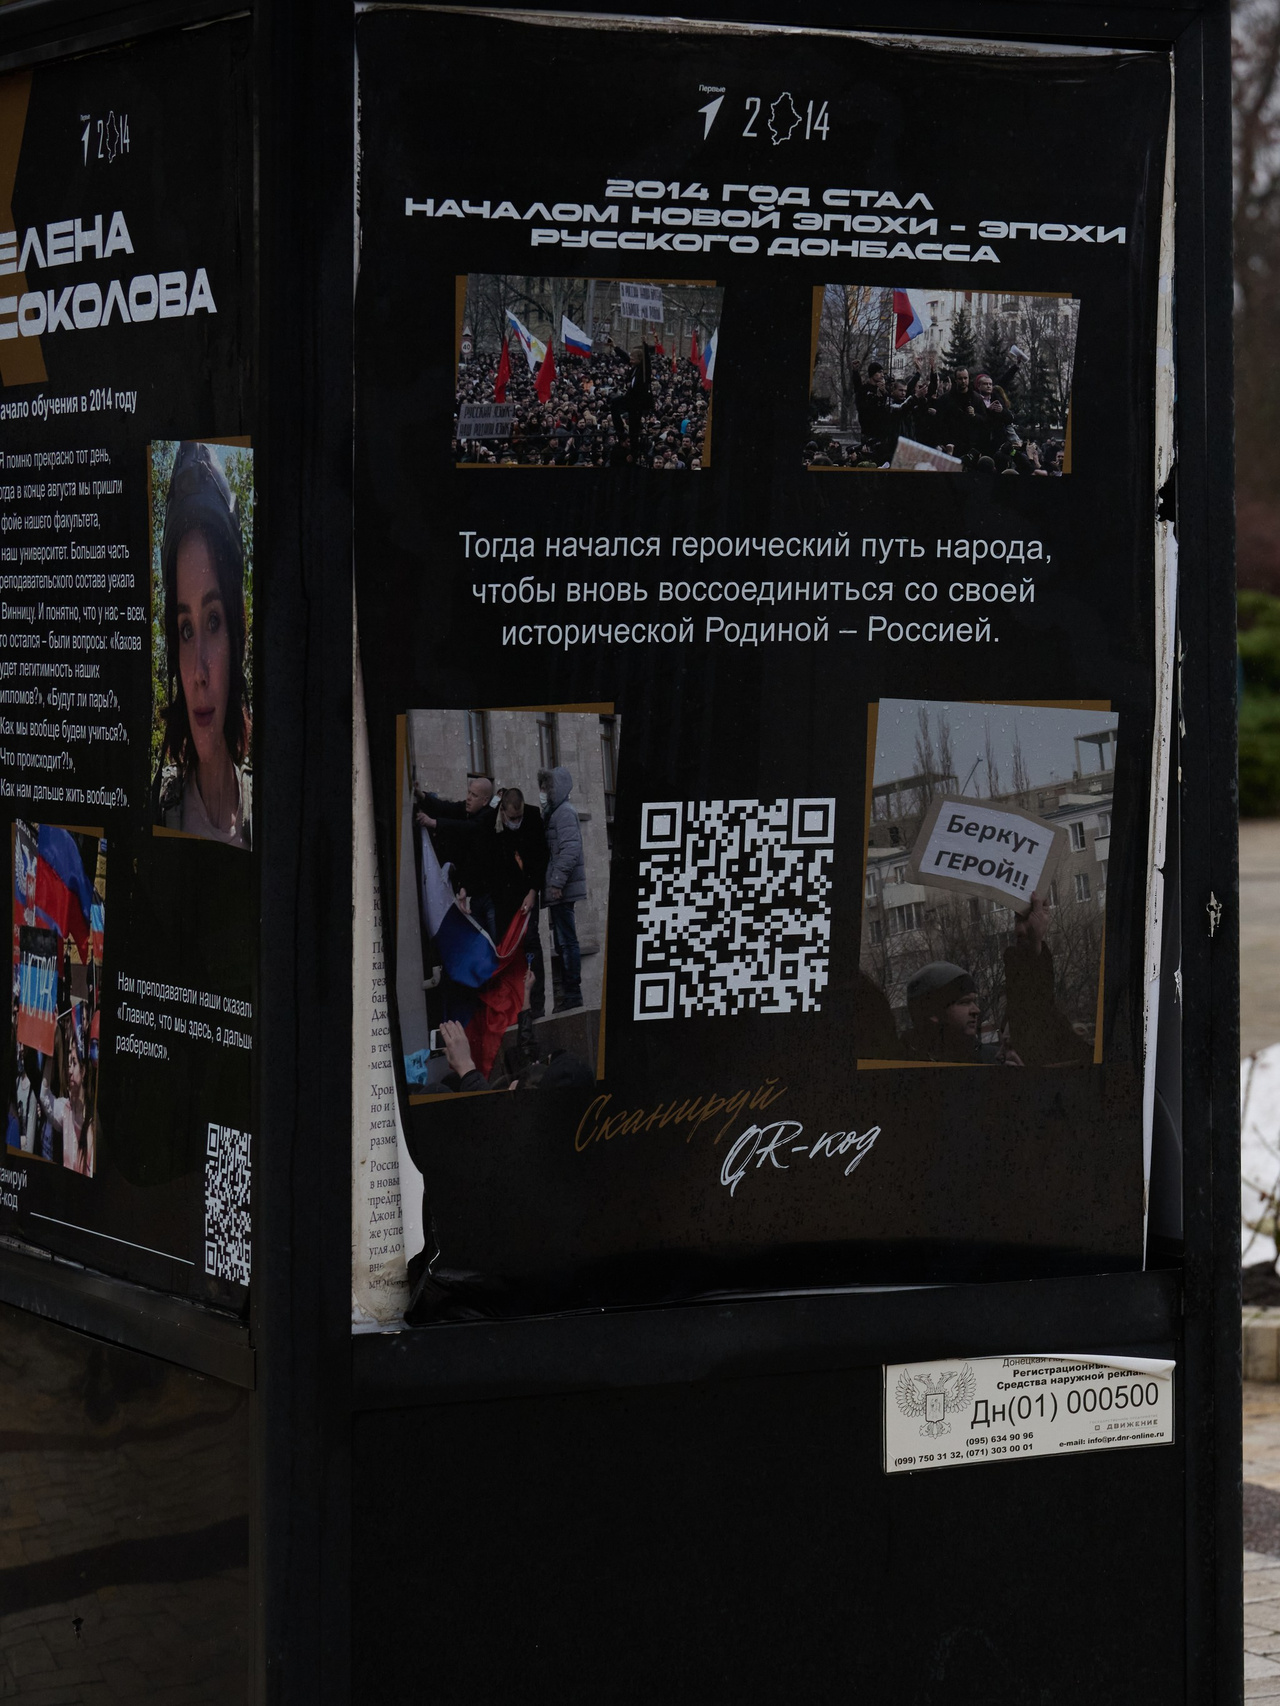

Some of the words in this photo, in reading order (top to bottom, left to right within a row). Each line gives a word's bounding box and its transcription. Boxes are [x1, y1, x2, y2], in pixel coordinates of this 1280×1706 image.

[699, 84, 726, 94] Первые
[605, 179, 709, 201] 2014
[723, 181, 812, 207] ГОД
[822, 188, 934, 211] СТАЛ
[403, 197, 620, 224] НАЧАЛОМ
[630, 204, 782, 229] НОВОЙ
[792, 211, 939, 236] ЭПОХИ
[977, 220, 1127, 245] ЭПОХИ
[530, 228, 760, 255] РУССКОГО
[766, 234, 1002, 264] ДОНБАССА
[0, 400, 28, 420] ачало
[31, 394, 79, 421] обучения
[81, 397, 87, 411] в
[89, 387, 113, 410] 2014
[115, 389, 137, 414] году
[6, 454, 32, 469] помню
[34, 452, 75, 471] прекрасно
[75, 450, 89, 464] тот
[90, 448, 111, 467] день,
[0, 486, 15, 503] огда
[17, 486, 22, 499] в
[23, 484, 46, 501] конце
[47, 482, 76, 502] августа
[78, 482, 91, 496] мы
[93, 480, 123, 500] пришли
[1, 512, 23, 534] фойе
[24, 514, 52, 530] нашего
[54, 510, 100, 533] факультета,
[1, 547, 17, 561] наш
[19, 546, 69, 565] университет.
[70, 541, 106, 560] Большая
[107, 544, 130, 560] часть
[459, 531, 536, 560] Тогда
[545, 535, 661, 557] начался
[671, 532, 851, 565] героический
[861, 539, 926, 566] путь
[936, 538, 1052, 564] народа,
[0, 574, 73, 594] реподавательского
[75, 573, 106, 589] состава
[108, 573, 135, 593] уехала
[472, 576, 556, 604] чтобы
[566, 582, 648, 603] вновь
[658, 577, 894, 607] воссоединиться
[904, 581, 938, 602] со
[948, 576, 1036, 604] своей
[1, 602, 36, 625] Винницу.
[38, 602, 45, 619] И
[45, 605, 81, 623] понятно,
[82, 606, 96, 621] что
[97, 607, 103, 625] у
[104, 606, 119, 621] нас
[127, 608, 147, 624] всех,
[10, 634, 40, 649] остался
[49, 631, 71, 649] были
[73, 635, 107, 653] вопросы:
[110, 632, 142, 651] «Какова
[501, 615, 695, 651] исторической
[705, 615, 830, 646] Родиной
[868, 613, 1001, 643] Россией.
[0, 662, 17, 680] удет
[19, 662, 73, 678] легитимность
[75, 664, 100, 679] наших
[0, 686, 45, 708] ипломов?»,
[47, 687, 75, 711] «Будут
[77, 693, 87, 707] ли
[89, 689, 121, 712] пары?»,
[16, 721, 28, 735] мы
[30, 719, 60, 739] вообще
[61, 719, 87, 743] будем
[88, 722, 130, 745] учиться?»,
[16, 751, 76, 773] происходит?!»,
[16, 783, 32, 798] нам
[33, 784, 64, 802] дальше
[65, 788, 84, 803] жить
[86, 786, 130, 809] вообще?!».
[947, 814, 1039, 855] Беркут
[934, 850, 1029, 891] ГЕРОЙ!!
[117, 970, 135, 993] Нам
[136, 978, 198, 1006] преподаватели
[199, 991, 221, 1011] наши
[371, 977, 387, 991] уез
[371, 991, 387, 1004] бан
[117, 1002, 157, 1031] «Главное,
[159, 1013, 172, 1031] что
[174, 1016, 187, 1034] мы
[188, 1020, 214, 1043] здесь,
[216, 1026, 222, 1042] а
[371, 1009, 388, 1023] Дж
[116, 1033, 170, 1061] разберемся».
[371, 1060, 392, 1071] меха
[371, 1084, 394, 1099] Хрон
[370, 1104, 382, 1114] но
[384, 1103, 390, 1112] и
[575, 1077, 788, 1152] Сканируй
[370, 1118, 396, 1131] метал
[720, 1119, 882, 1197] QR-код
[0, 1168, 28, 1191] анируй
[377, 1177, 400, 1189] новы
[369, 1193, 402, 1209] предпр
[369, 1210, 396, 1225] Джон
[369, 1229, 381, 1240] же
[384, 1226, 404, 1241] успе
[369, 1244, 388, 1260] угля
[389, 1243, 401, 1255] до
[1002, 1357, 1046, 1368] Донецкая
[997, 1378, 1047, 1391] Средства
[1050, 1371, 1104, 1385] наружной
[1107, 1370, 1147, 1381] рекла
[970, 1392, 1058, 1430] Дн(01)
[1066, 1382, 1159, 1415] 000500
[1106, 1419, 1159, 1431] ДВИЖЕНИЕ
[966, 1435, 989, 1448] (095)
[991, 1433, 1008, 1445] 634
[1009, 1432, 1021, 1443] 90
[1022, 1431, 1034, 1441] 96
[1058, 1439, 1086, 1448] e-mail:
[894, 1453, 917, 1467] (099)
[918, 1452, 935, 1463] 750
[937, 1452, 948, 1462] 31
[949, 1450, 964, 1461] 32,
[966, 1446, 989, 1459] (071)
[991, 1445, 1008, 1456] 303
[1009, 1443, 1022, 1454] 00
[1022, 1442, 1034, 1453] 01
